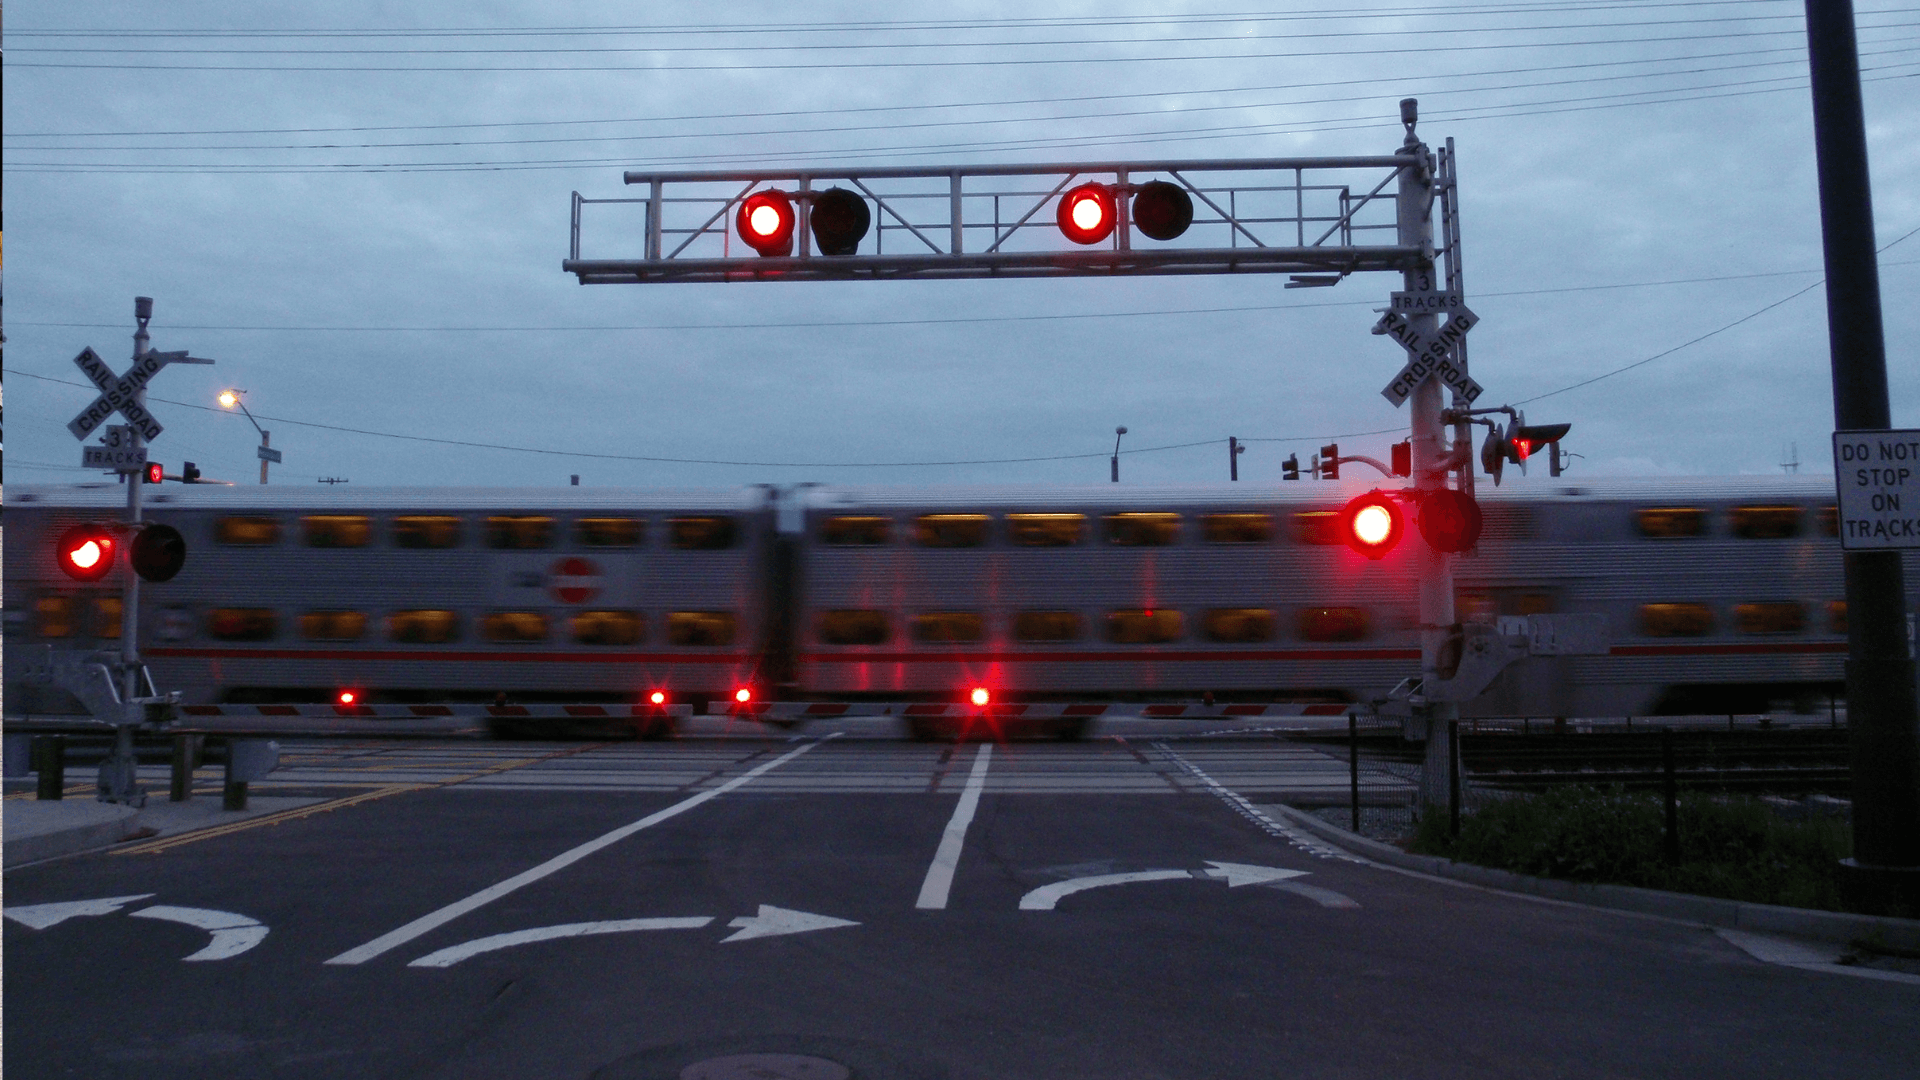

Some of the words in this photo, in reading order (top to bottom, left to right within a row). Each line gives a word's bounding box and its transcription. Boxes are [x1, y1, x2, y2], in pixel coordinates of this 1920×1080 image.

[1418, 274, 1430, 291] 3
[1394, 295, 1458, 309] TRACKS
[1382, 312, 1419, 353] RAIL
[1436, 360, 1481, 403] ROAD
[1392, 315, 1470, 398] CROSSING
[77, 350, 112, 391] RAIL
[121, 398, 161, 442] ROAD
[78, 357, 158, 432] CROSSING
[109, 431, 120, 447] 3
[85, 451, 144, 464] TRACKS
[1842, 443, 1869, 461] DO
[1880, 442, 1919, 460] NOT
[1857, 468, 1910, 486] STOP
[1871, 493, 1900, 511] ON
[1846, 519, 1920, 538] TRACK
